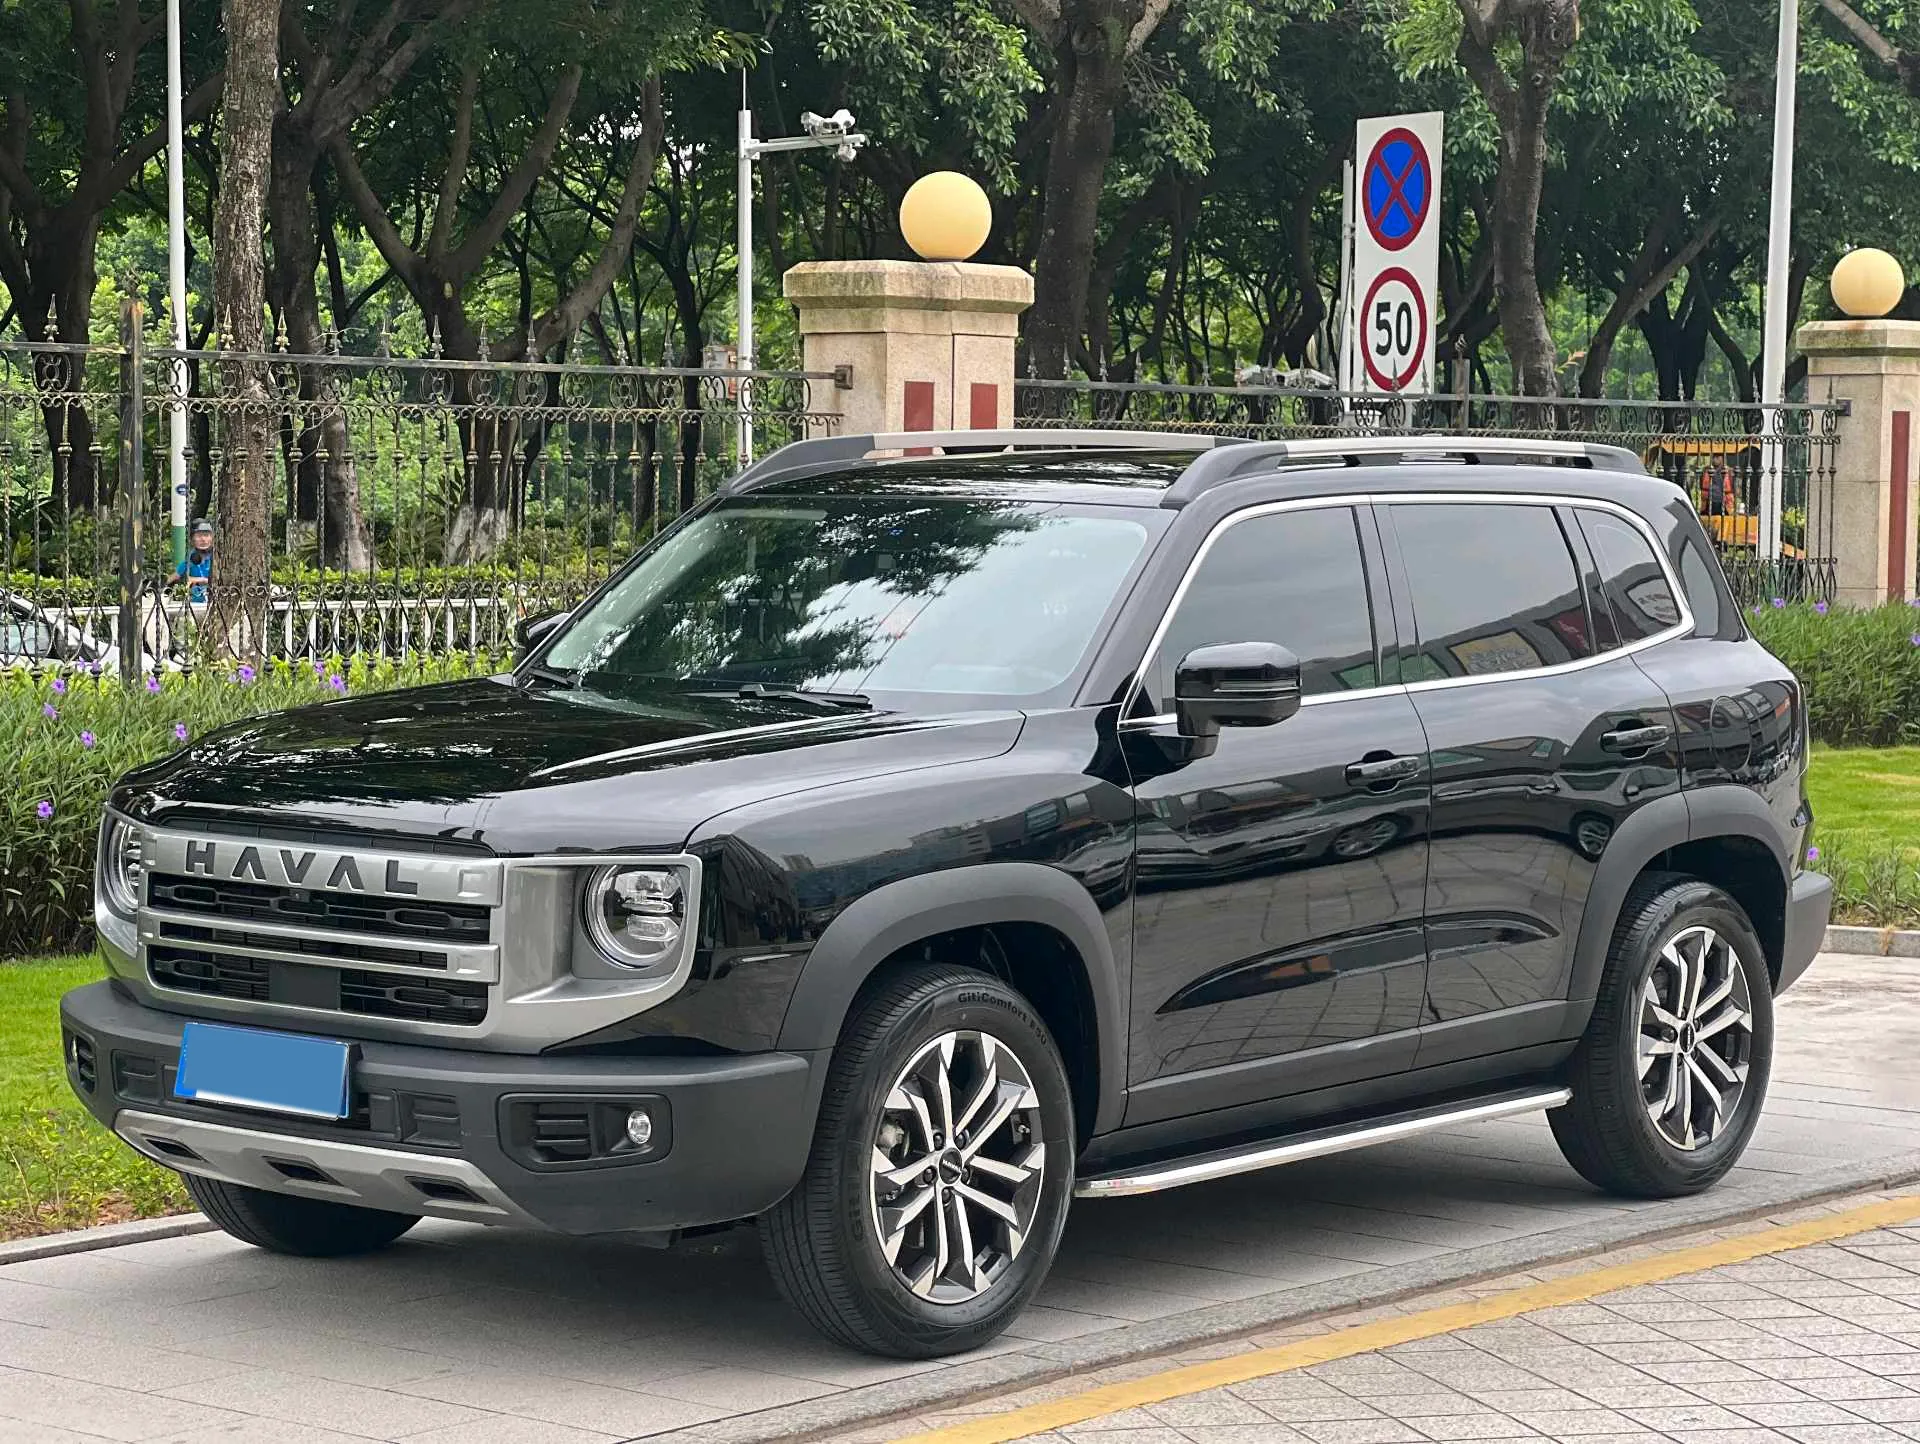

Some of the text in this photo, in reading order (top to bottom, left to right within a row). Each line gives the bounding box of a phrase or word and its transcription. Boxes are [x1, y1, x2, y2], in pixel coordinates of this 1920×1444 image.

[1375, 302, 1412, 356] 50
[185, 840, 418, 896] HAVAL
[958, 991, 1028, 1023] GitiComfort
